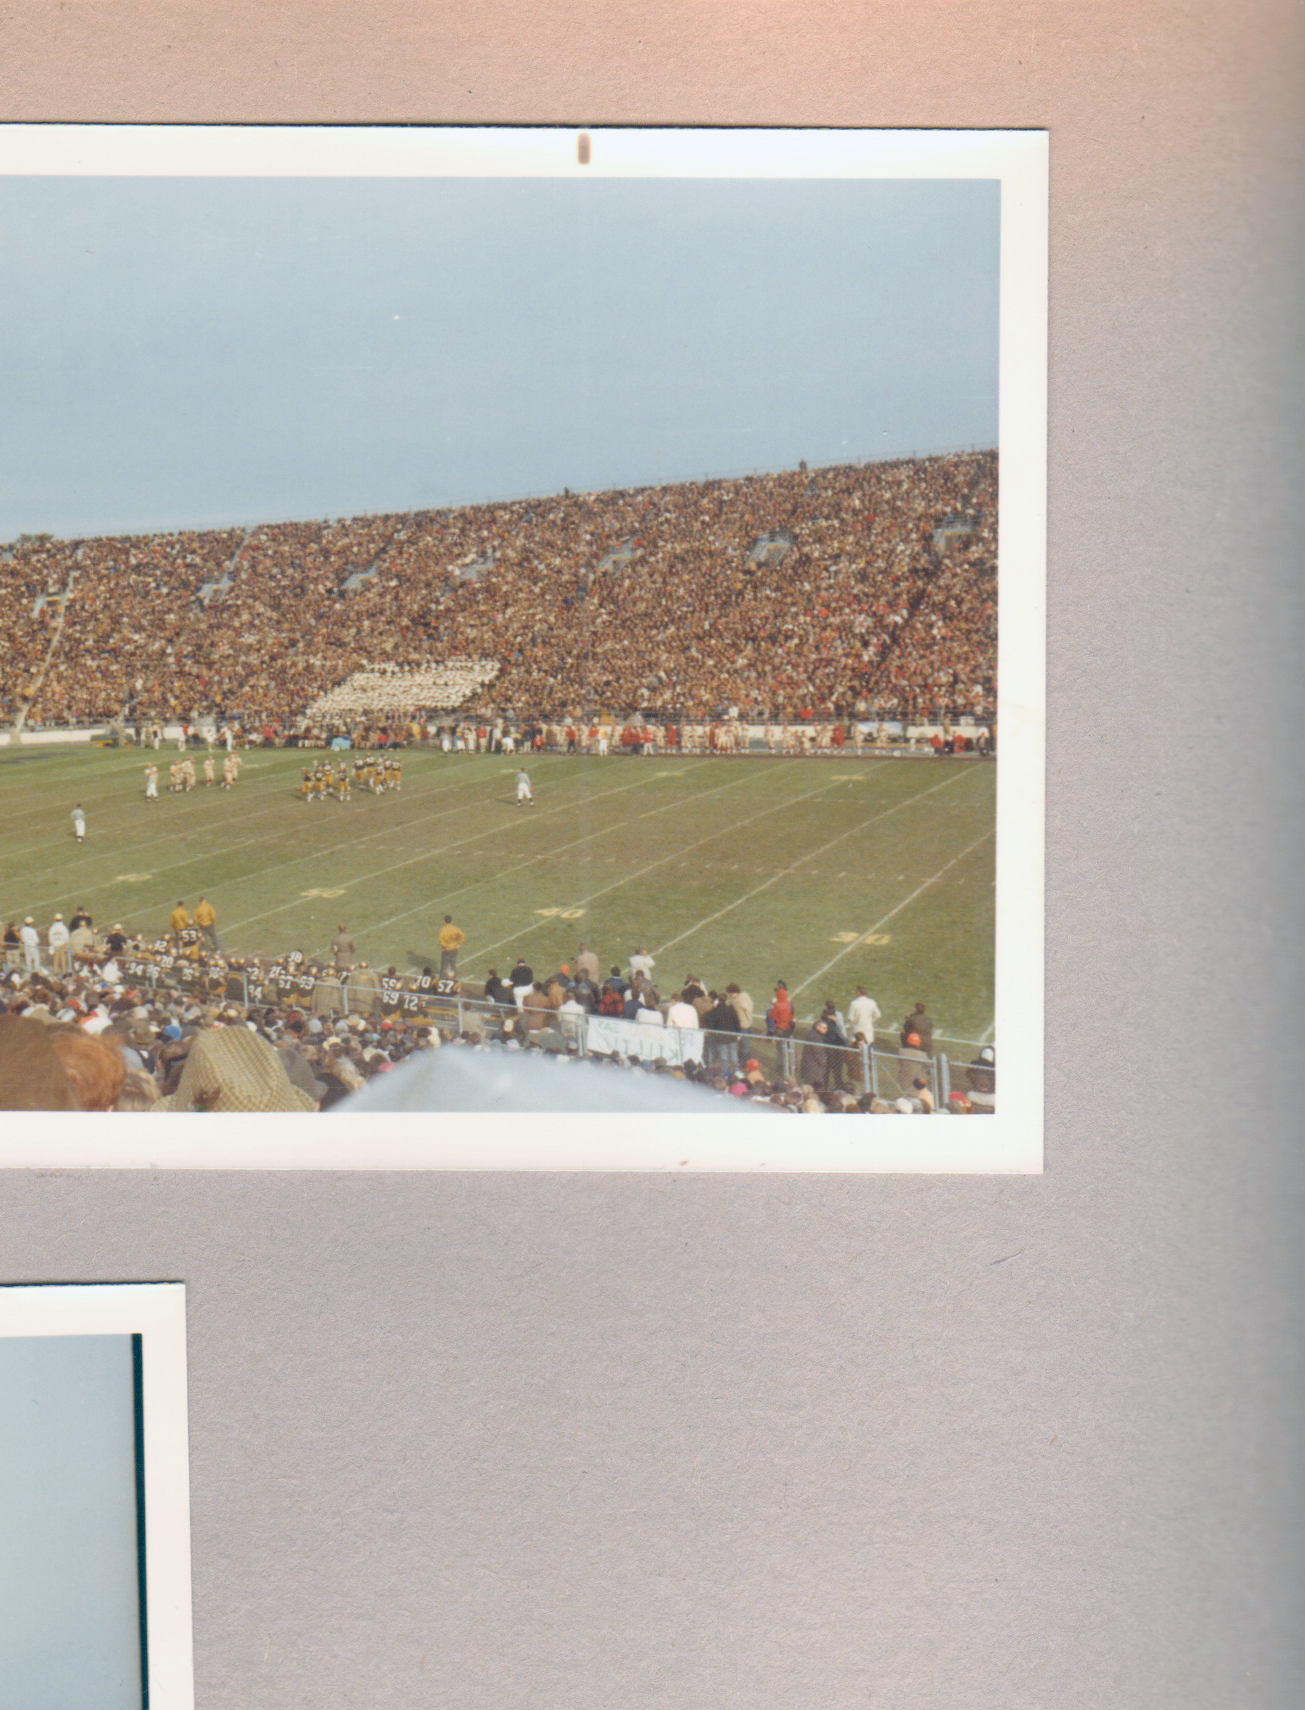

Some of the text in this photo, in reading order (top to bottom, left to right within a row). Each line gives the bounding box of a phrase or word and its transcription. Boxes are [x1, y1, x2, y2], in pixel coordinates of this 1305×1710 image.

[182, 929, 197, 942] 53
[416, 976, 432, 988] 70
[437, 979, 454, 993] 57
[382, 992, 399, 1005] 69
